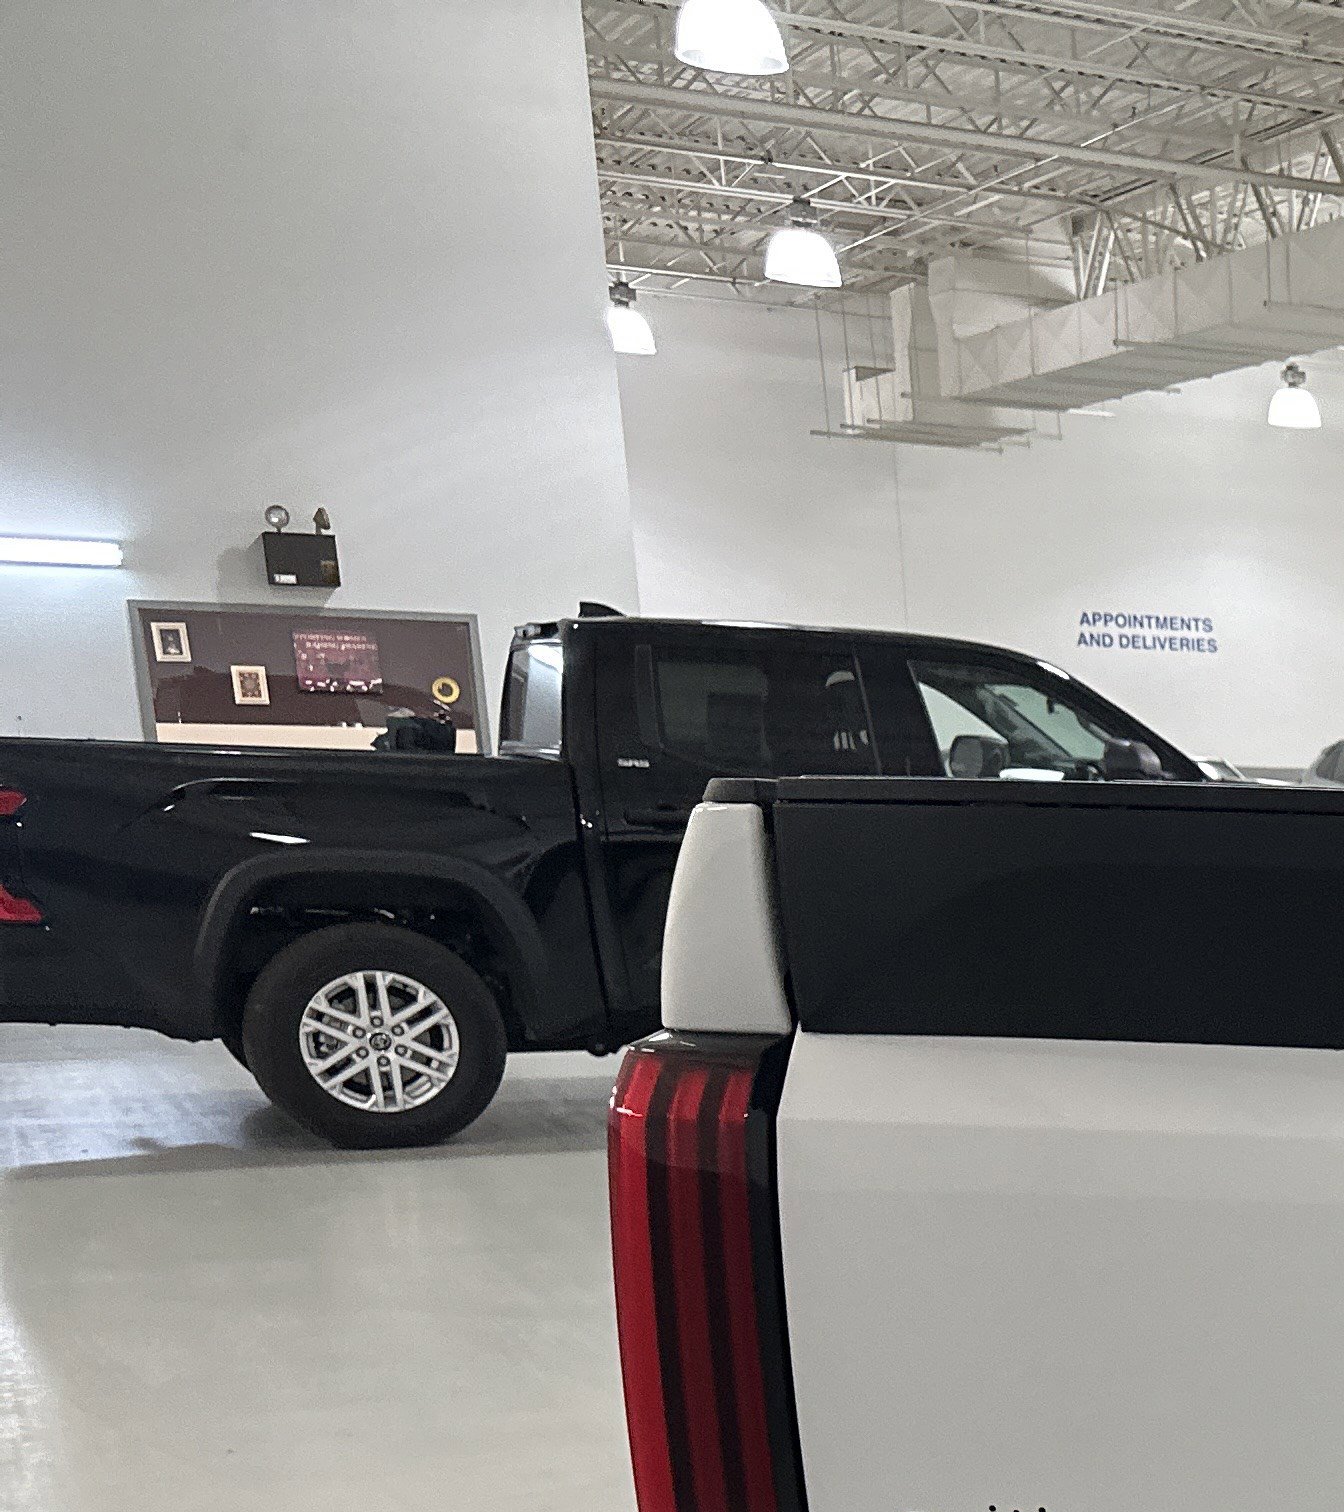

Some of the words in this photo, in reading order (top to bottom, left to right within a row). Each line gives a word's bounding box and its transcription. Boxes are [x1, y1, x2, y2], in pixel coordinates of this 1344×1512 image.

[1079, 611, 1214, 633] APPOINTMENTS
[1077, 632, 1114, 648] AND
[1119, 634, 1218, 653] DELIVERIES
